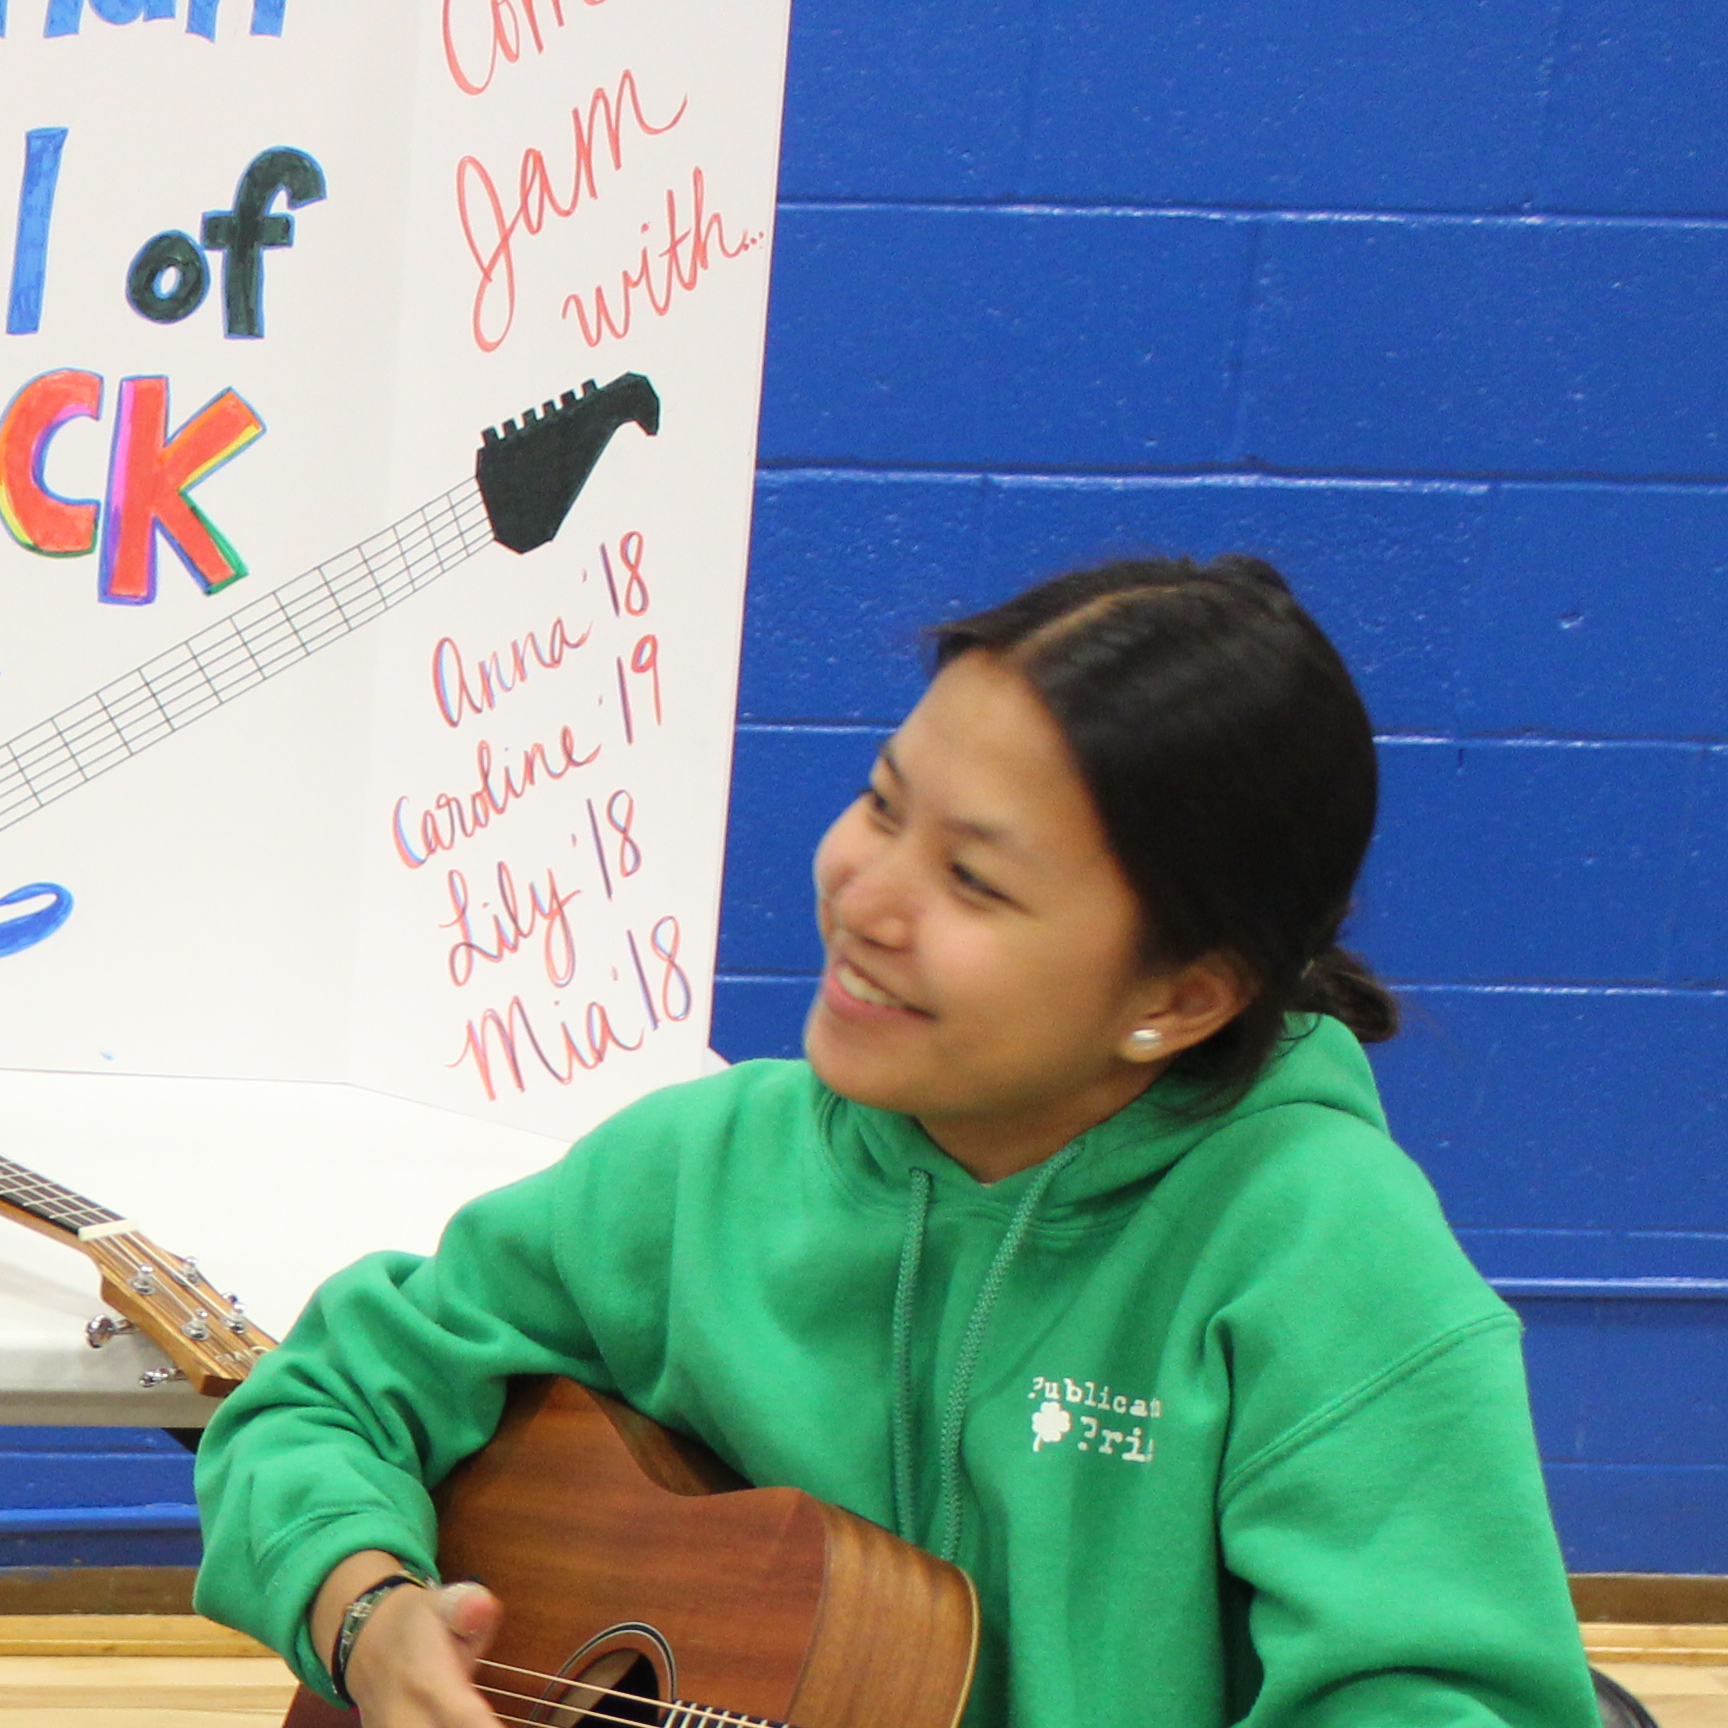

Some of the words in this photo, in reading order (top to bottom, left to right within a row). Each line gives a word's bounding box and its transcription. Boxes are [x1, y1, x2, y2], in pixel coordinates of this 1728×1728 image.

[125, 145, 328, 340] of
[455, 69, 688, 352] Jam
[431, 616, 593, 728] Anna
[391, 725, 603, 869] Caroline
[437, 860, 583, 988] Lily
[444, 993, 645, 1101] Mia
